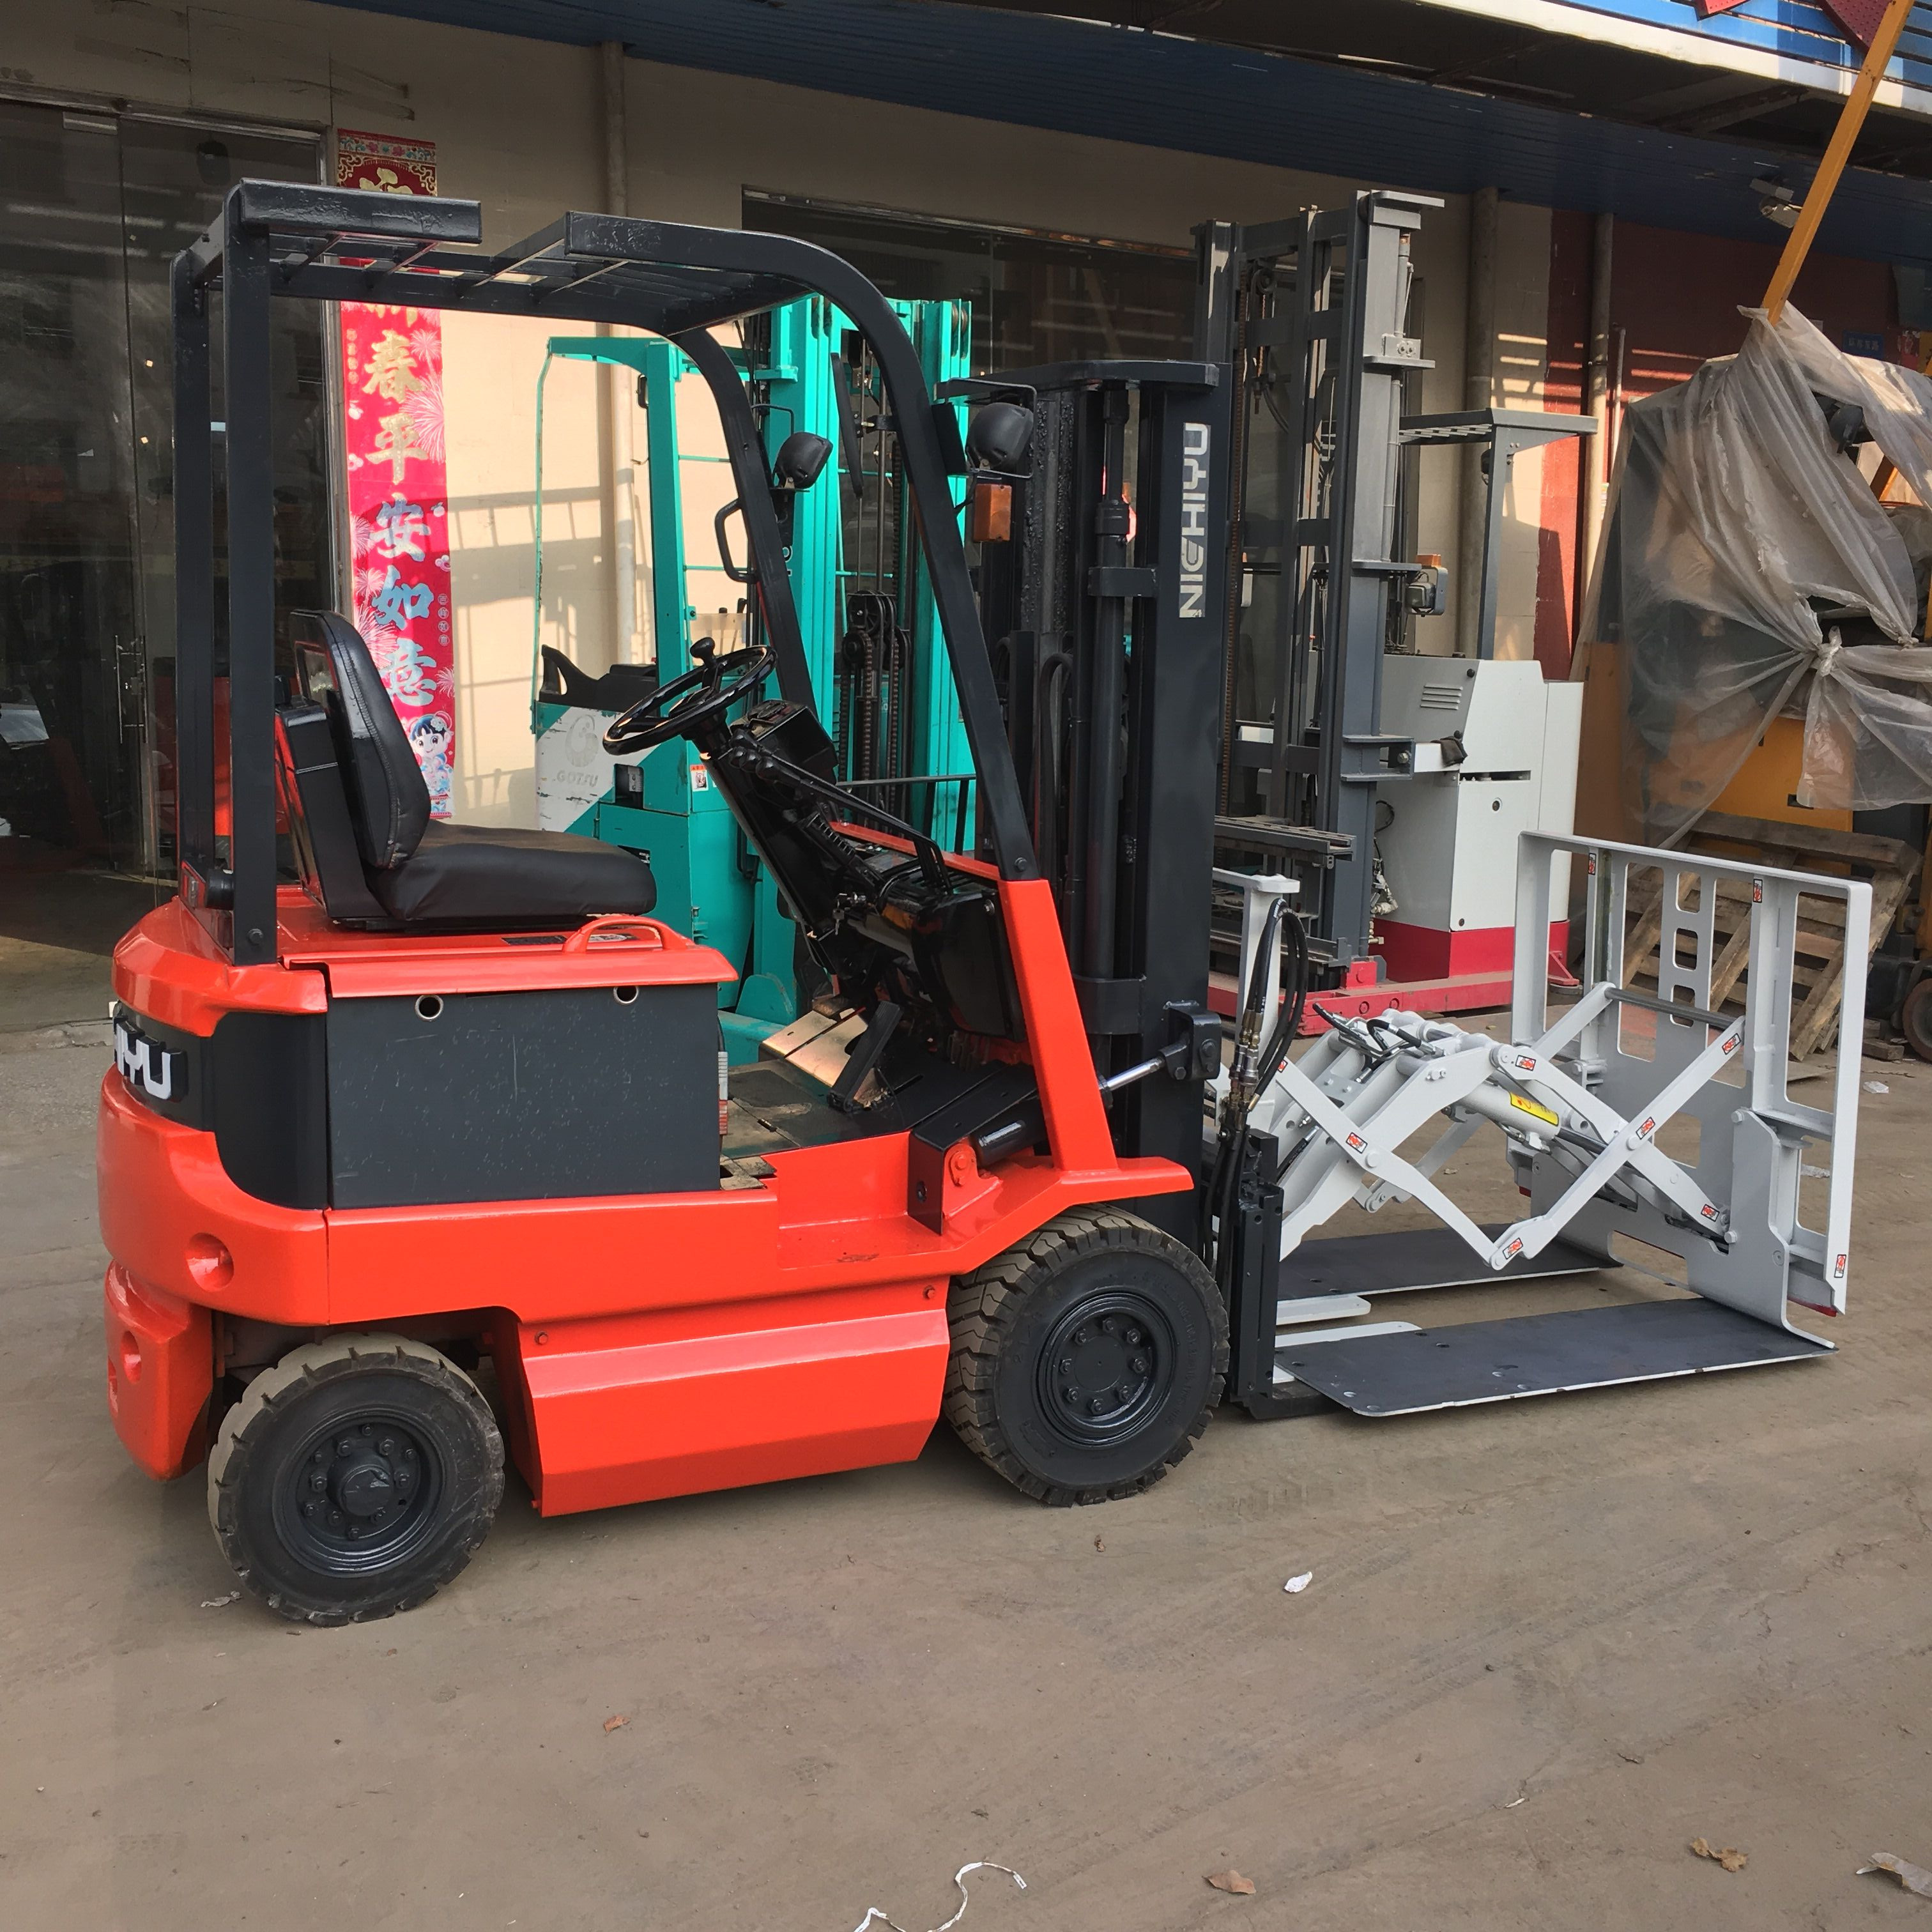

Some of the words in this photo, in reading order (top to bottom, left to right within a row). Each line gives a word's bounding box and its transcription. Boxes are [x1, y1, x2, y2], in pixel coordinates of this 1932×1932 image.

[362, 303, 437, 707] 春平安如意
[1179, 422, 1208, 618] NICHIYU
